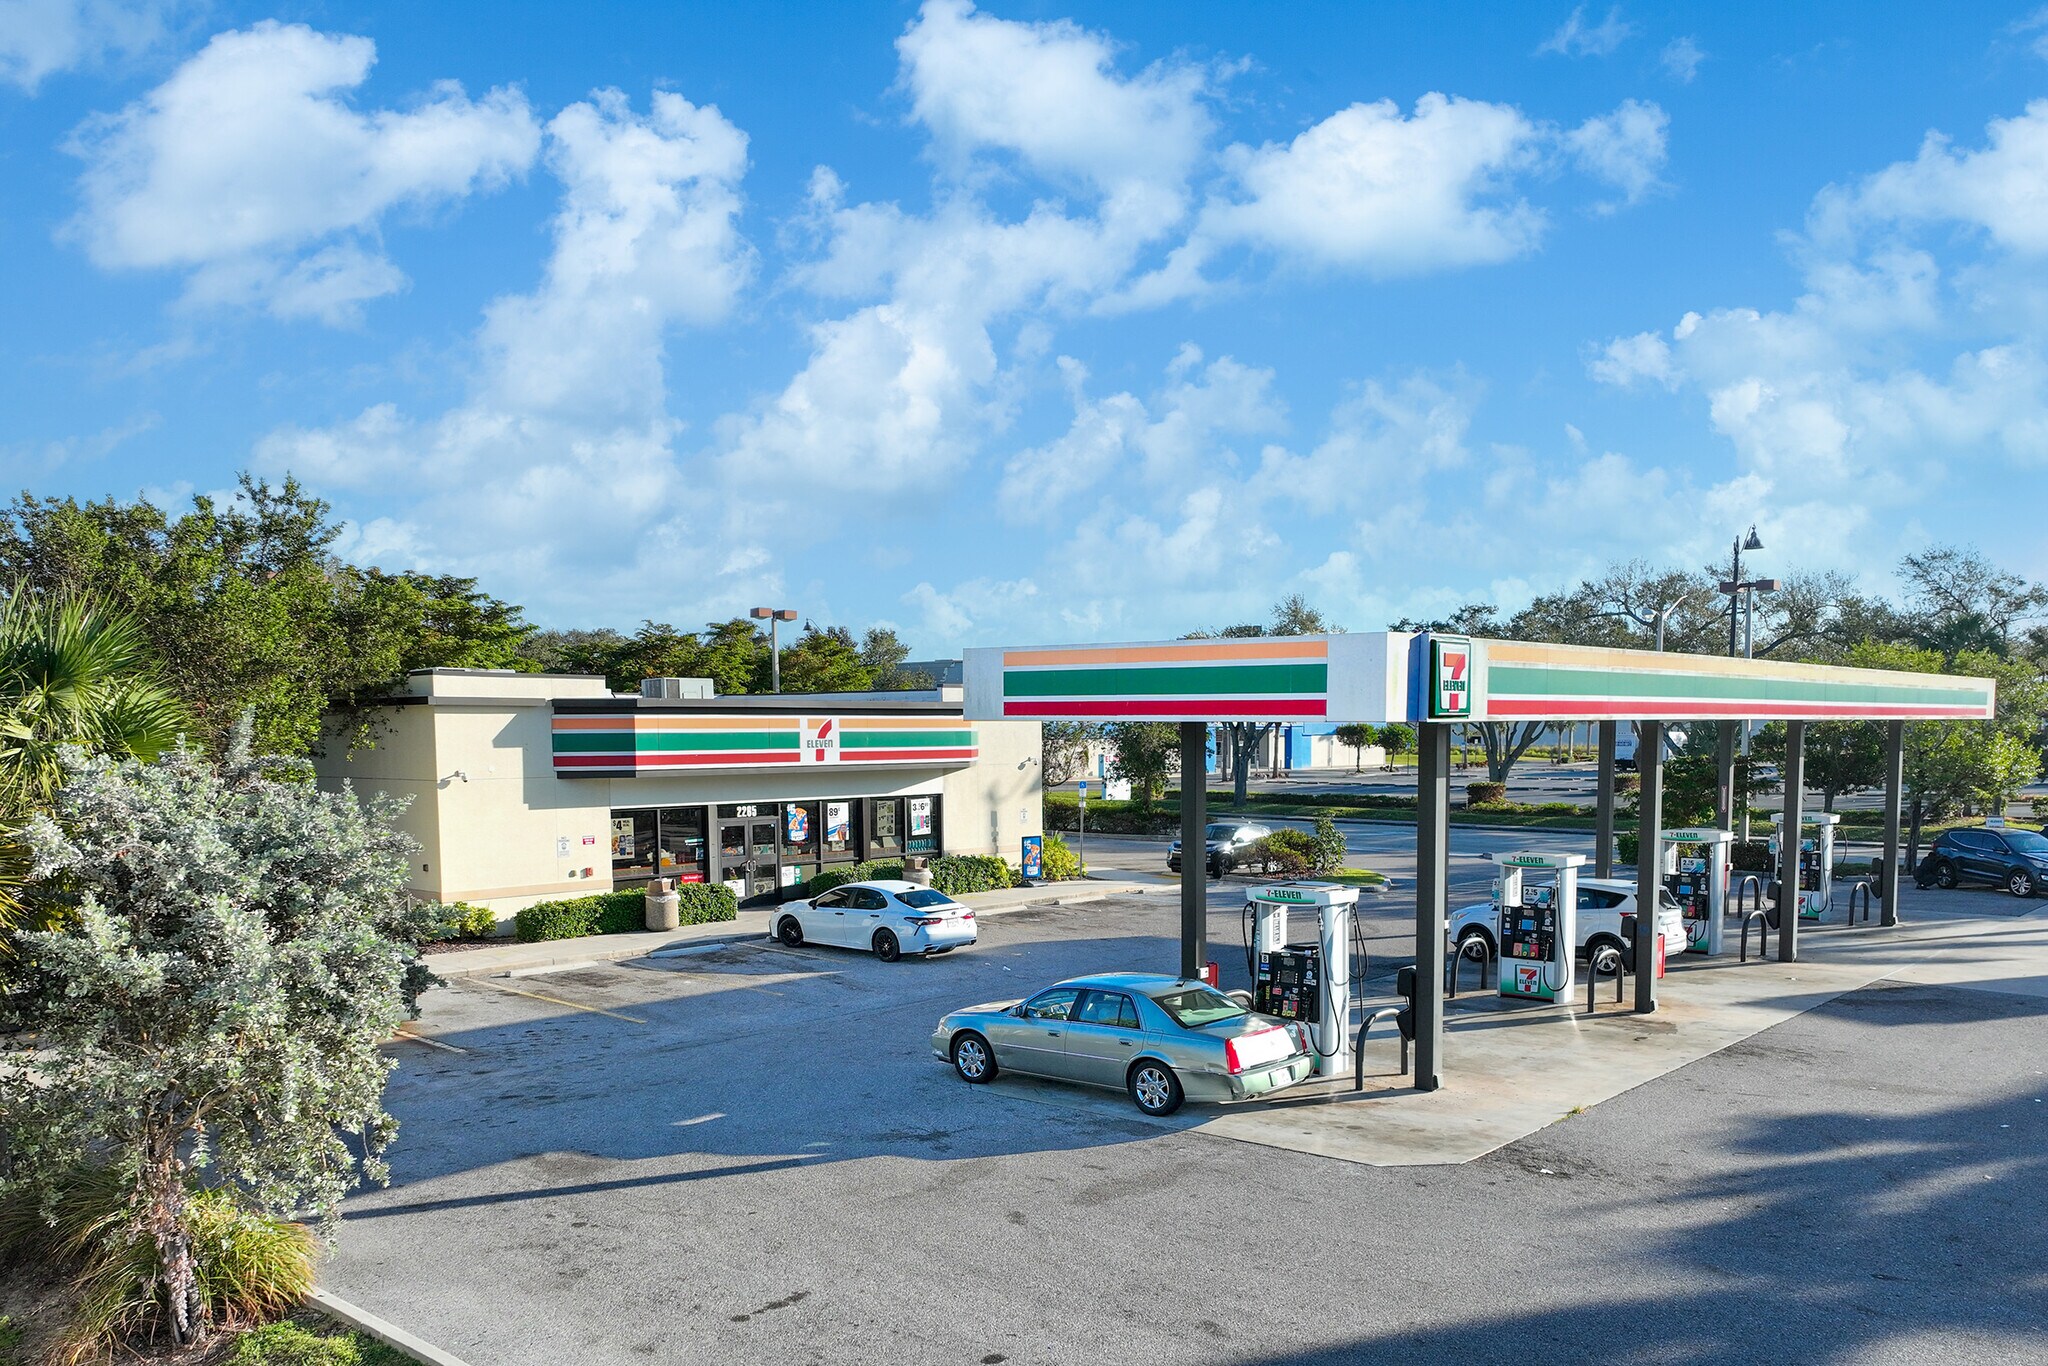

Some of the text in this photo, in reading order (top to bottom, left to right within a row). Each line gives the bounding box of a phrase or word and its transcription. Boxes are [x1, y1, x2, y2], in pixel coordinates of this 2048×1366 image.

[1444, 652, 1466, 711] 7
[807, 718, 832, 762] 7
[1519, 968, 1537, 992] 7
